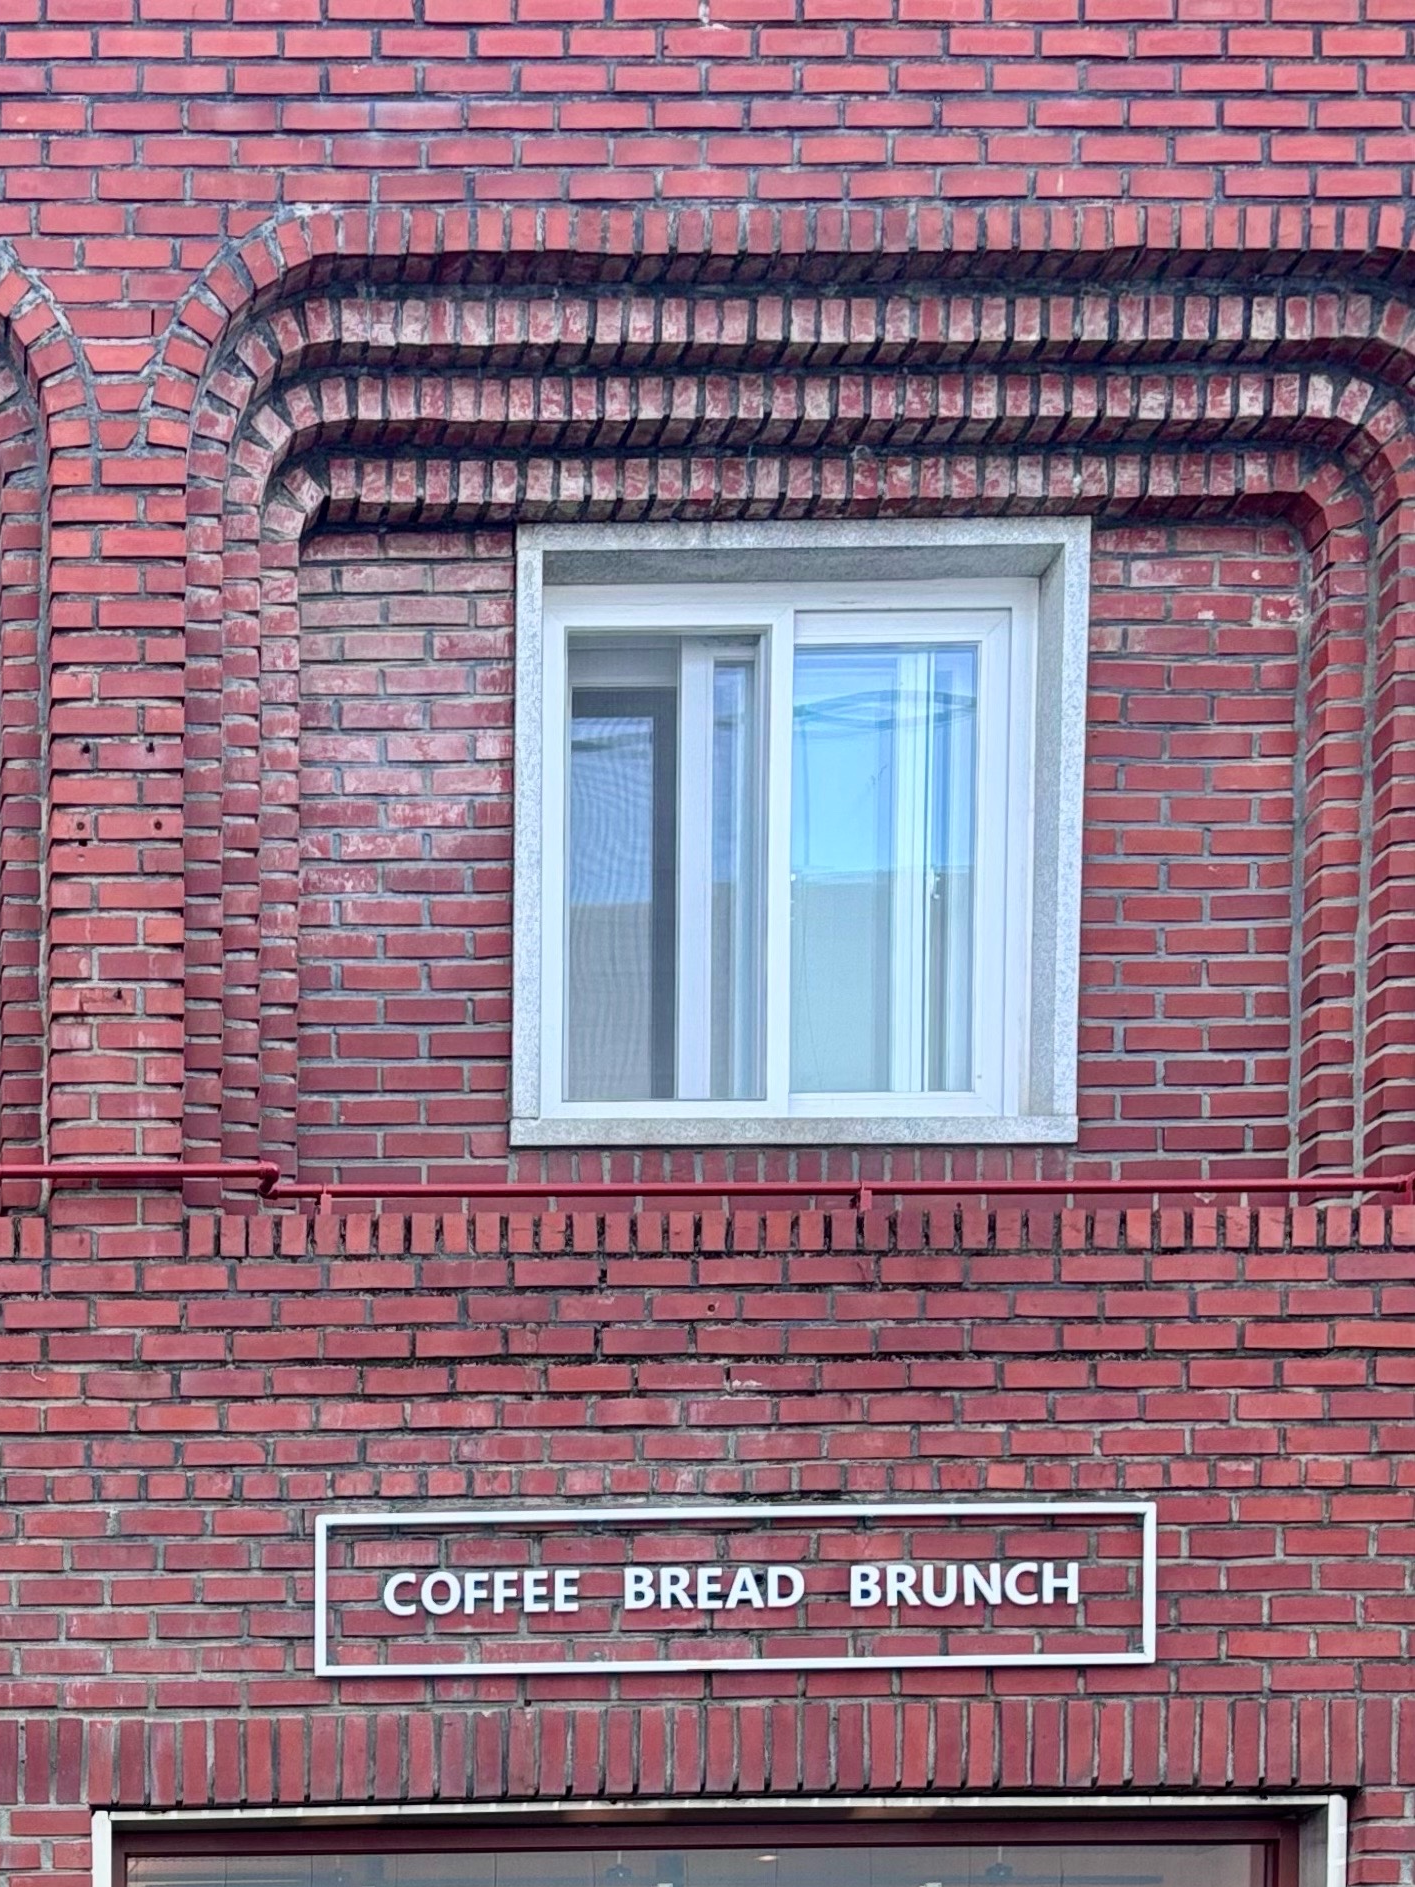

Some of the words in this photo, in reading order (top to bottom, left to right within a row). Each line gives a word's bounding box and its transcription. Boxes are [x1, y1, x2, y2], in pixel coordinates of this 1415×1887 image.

[383, 1568, 581, 1616] COFFEE
[623, 1565, 805, 1611] BREAD
[850, 1561, 1081, 1608] BRUNCH
